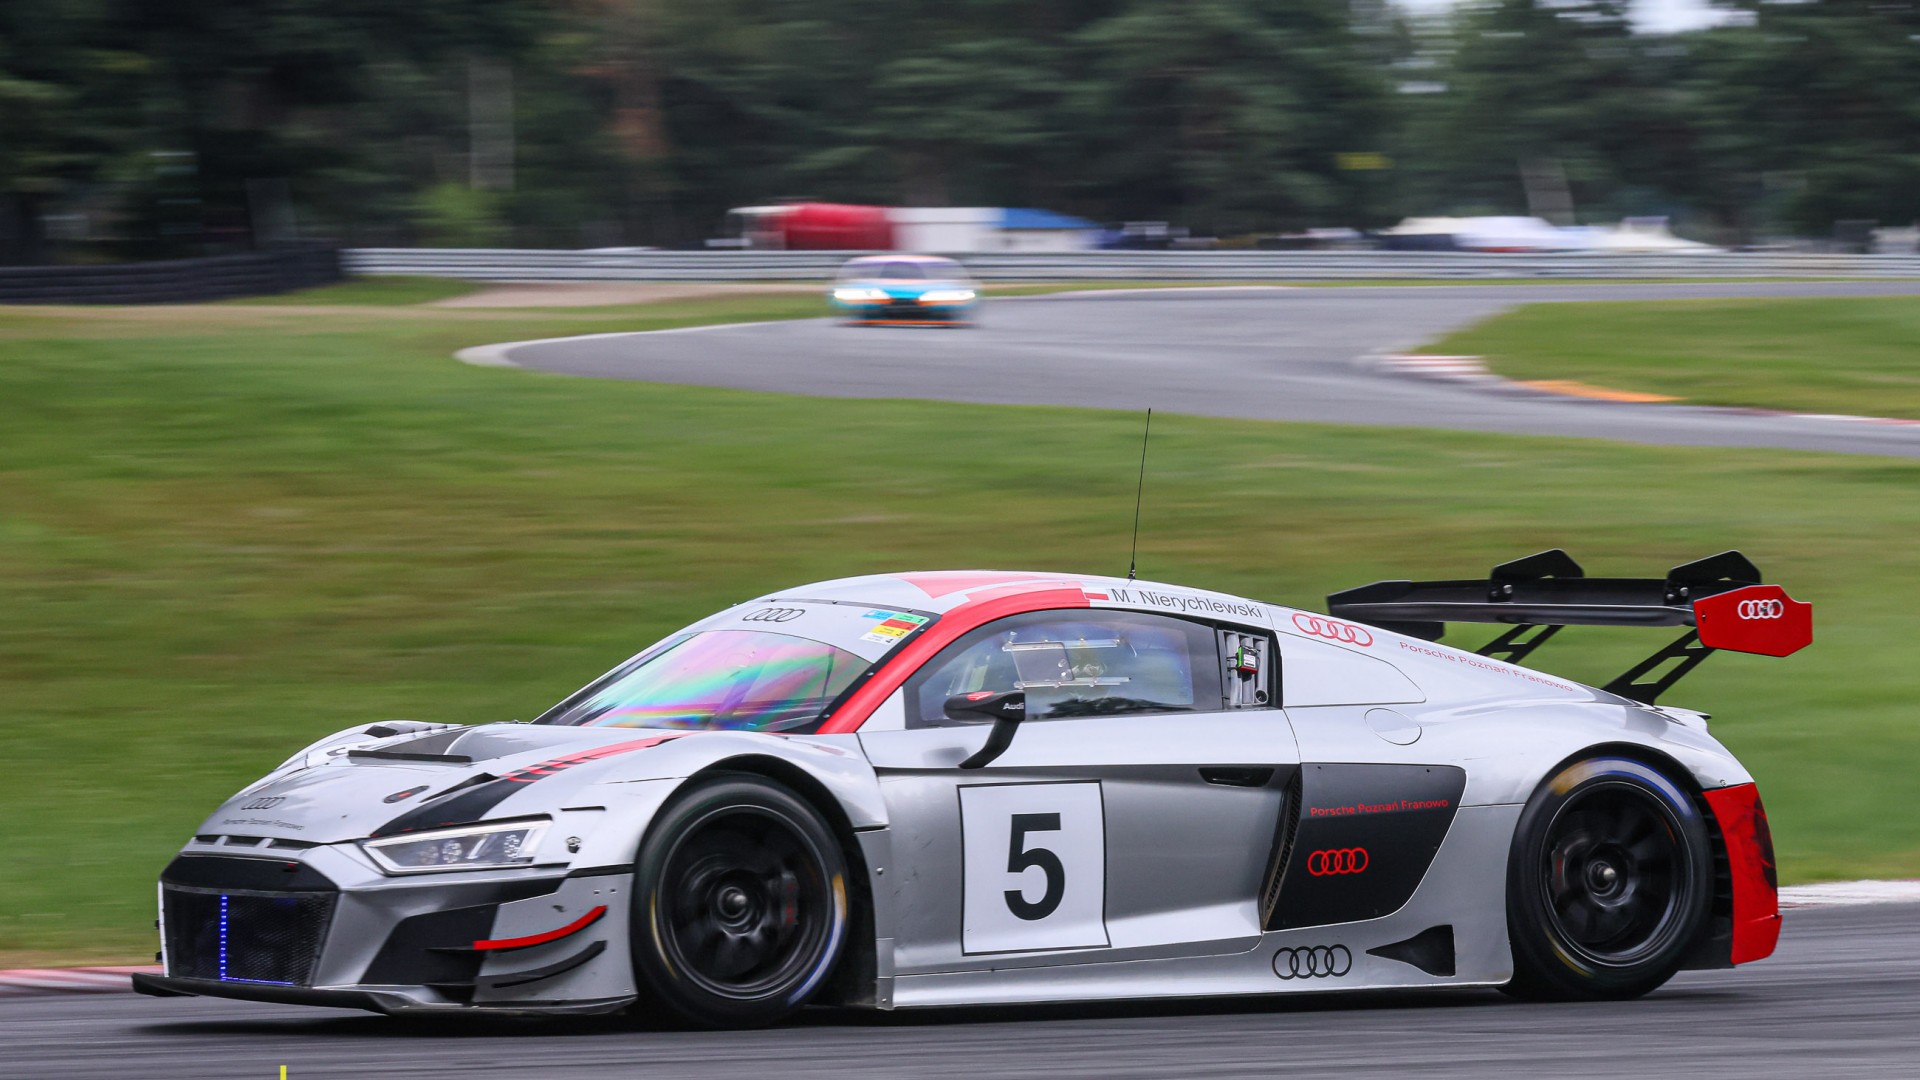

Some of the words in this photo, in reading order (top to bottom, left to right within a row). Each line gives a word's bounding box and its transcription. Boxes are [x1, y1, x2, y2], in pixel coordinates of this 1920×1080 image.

[1111, 588, 1136, 604] M.
[1138, 590, 1263, 618] Nierychlewski
[1399, 641, 1456, 662] Porsche
[1512, 669, 1574, 692] Franowo
[1002, 702, 1025, 710] Audi
[1309, 806, 1356, 817] Porsche
[1400, 799, 1449, 810] Franowo
[1003, 812, 1066, 921] 5
